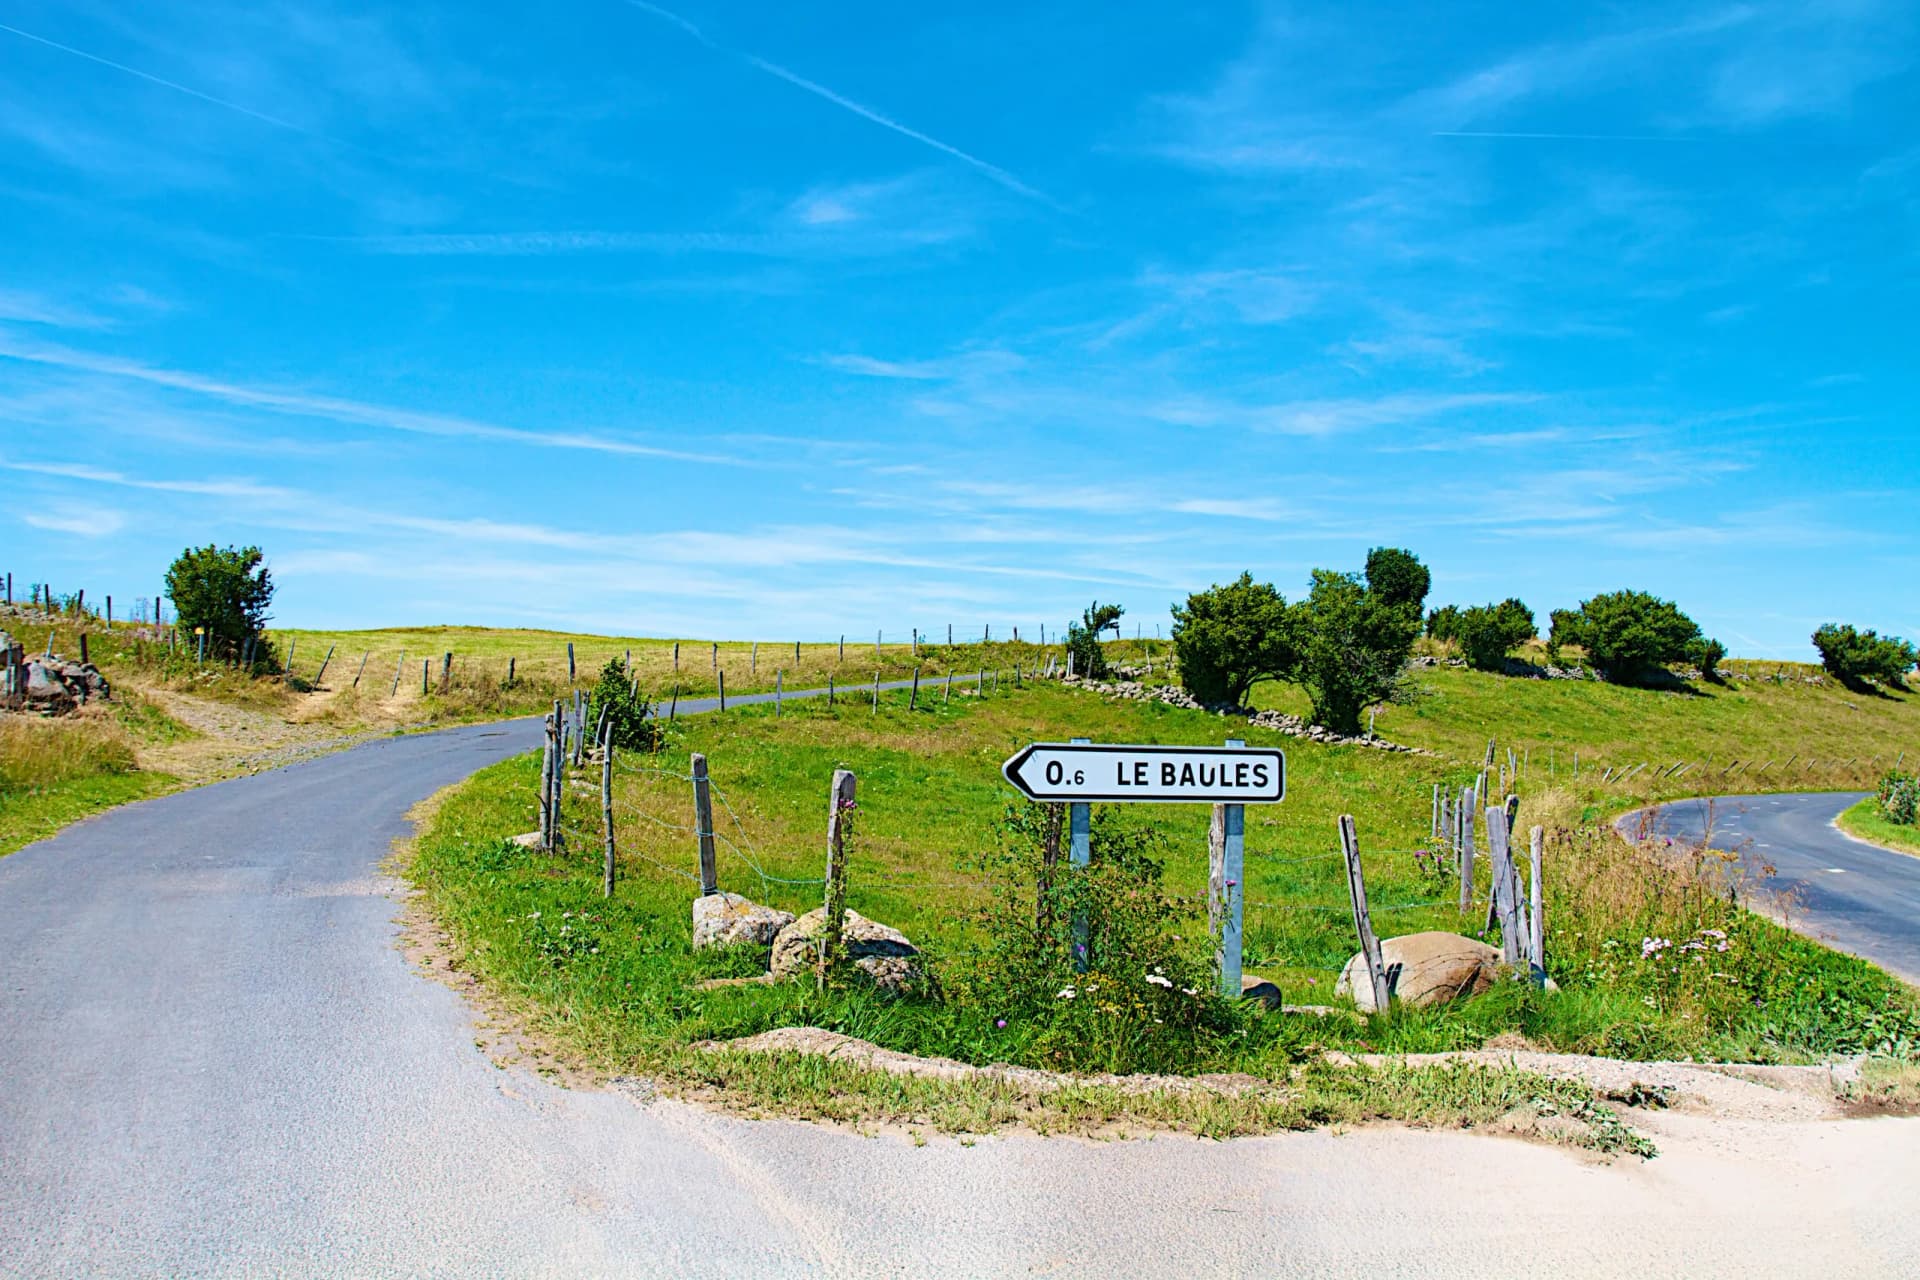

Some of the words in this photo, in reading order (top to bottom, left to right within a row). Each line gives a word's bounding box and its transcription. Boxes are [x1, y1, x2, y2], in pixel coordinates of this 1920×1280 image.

[1045, 760, 1085, 786] 0.6
[1117, 762, 1149, 786] LE
[1161, 762, 1270, 788] BAULES
